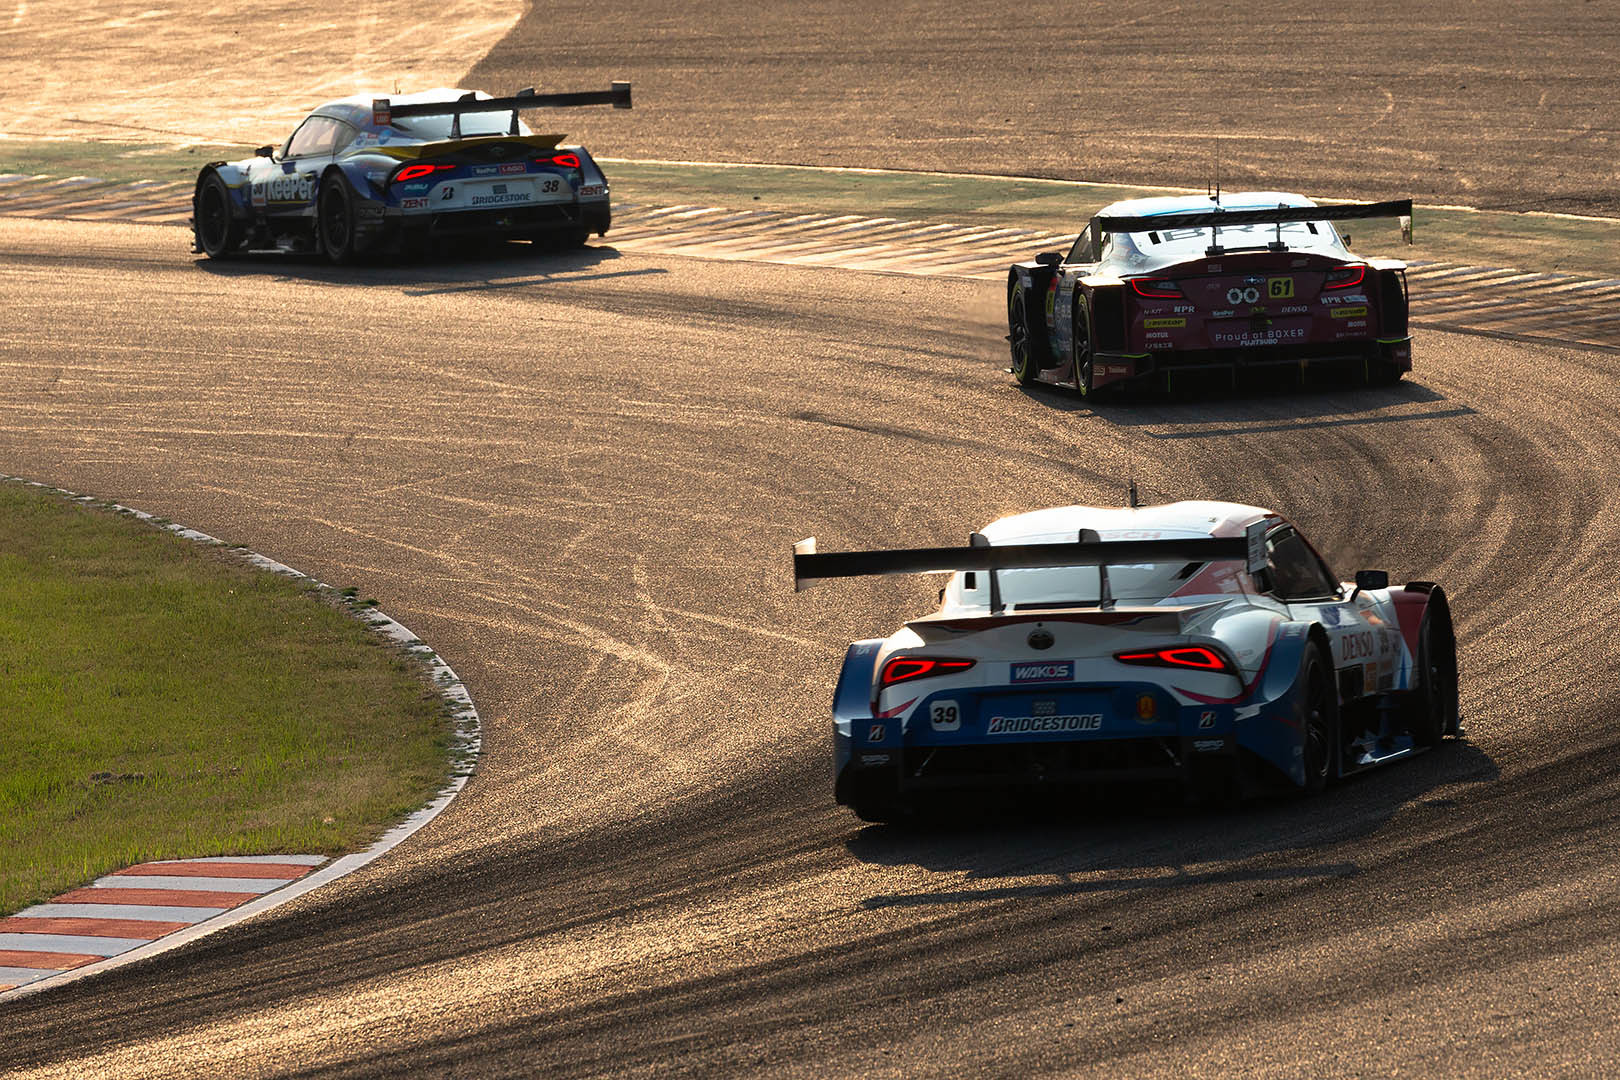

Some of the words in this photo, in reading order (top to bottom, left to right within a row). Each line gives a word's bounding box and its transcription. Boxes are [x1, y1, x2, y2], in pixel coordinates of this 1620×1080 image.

[542, 180, 560, 193] 38
[402, 199, 429, 209] ZENT
[472, 193, 532, 205] BRIDGESTONE
[1270, 280, 1291, 297] 61
[1173, 305, 1196, 313] NPR
[1281, 304, 1308, 313] DENSO
[1215, 332, 1248, 342] Proud
[1267, 328, 1304, 339] BOXER
[1342, 631, 1375, 660] DENSO
[933, 706, 957, 723] 39
[986, 714, 1103, 735] BRIDGESTONE
